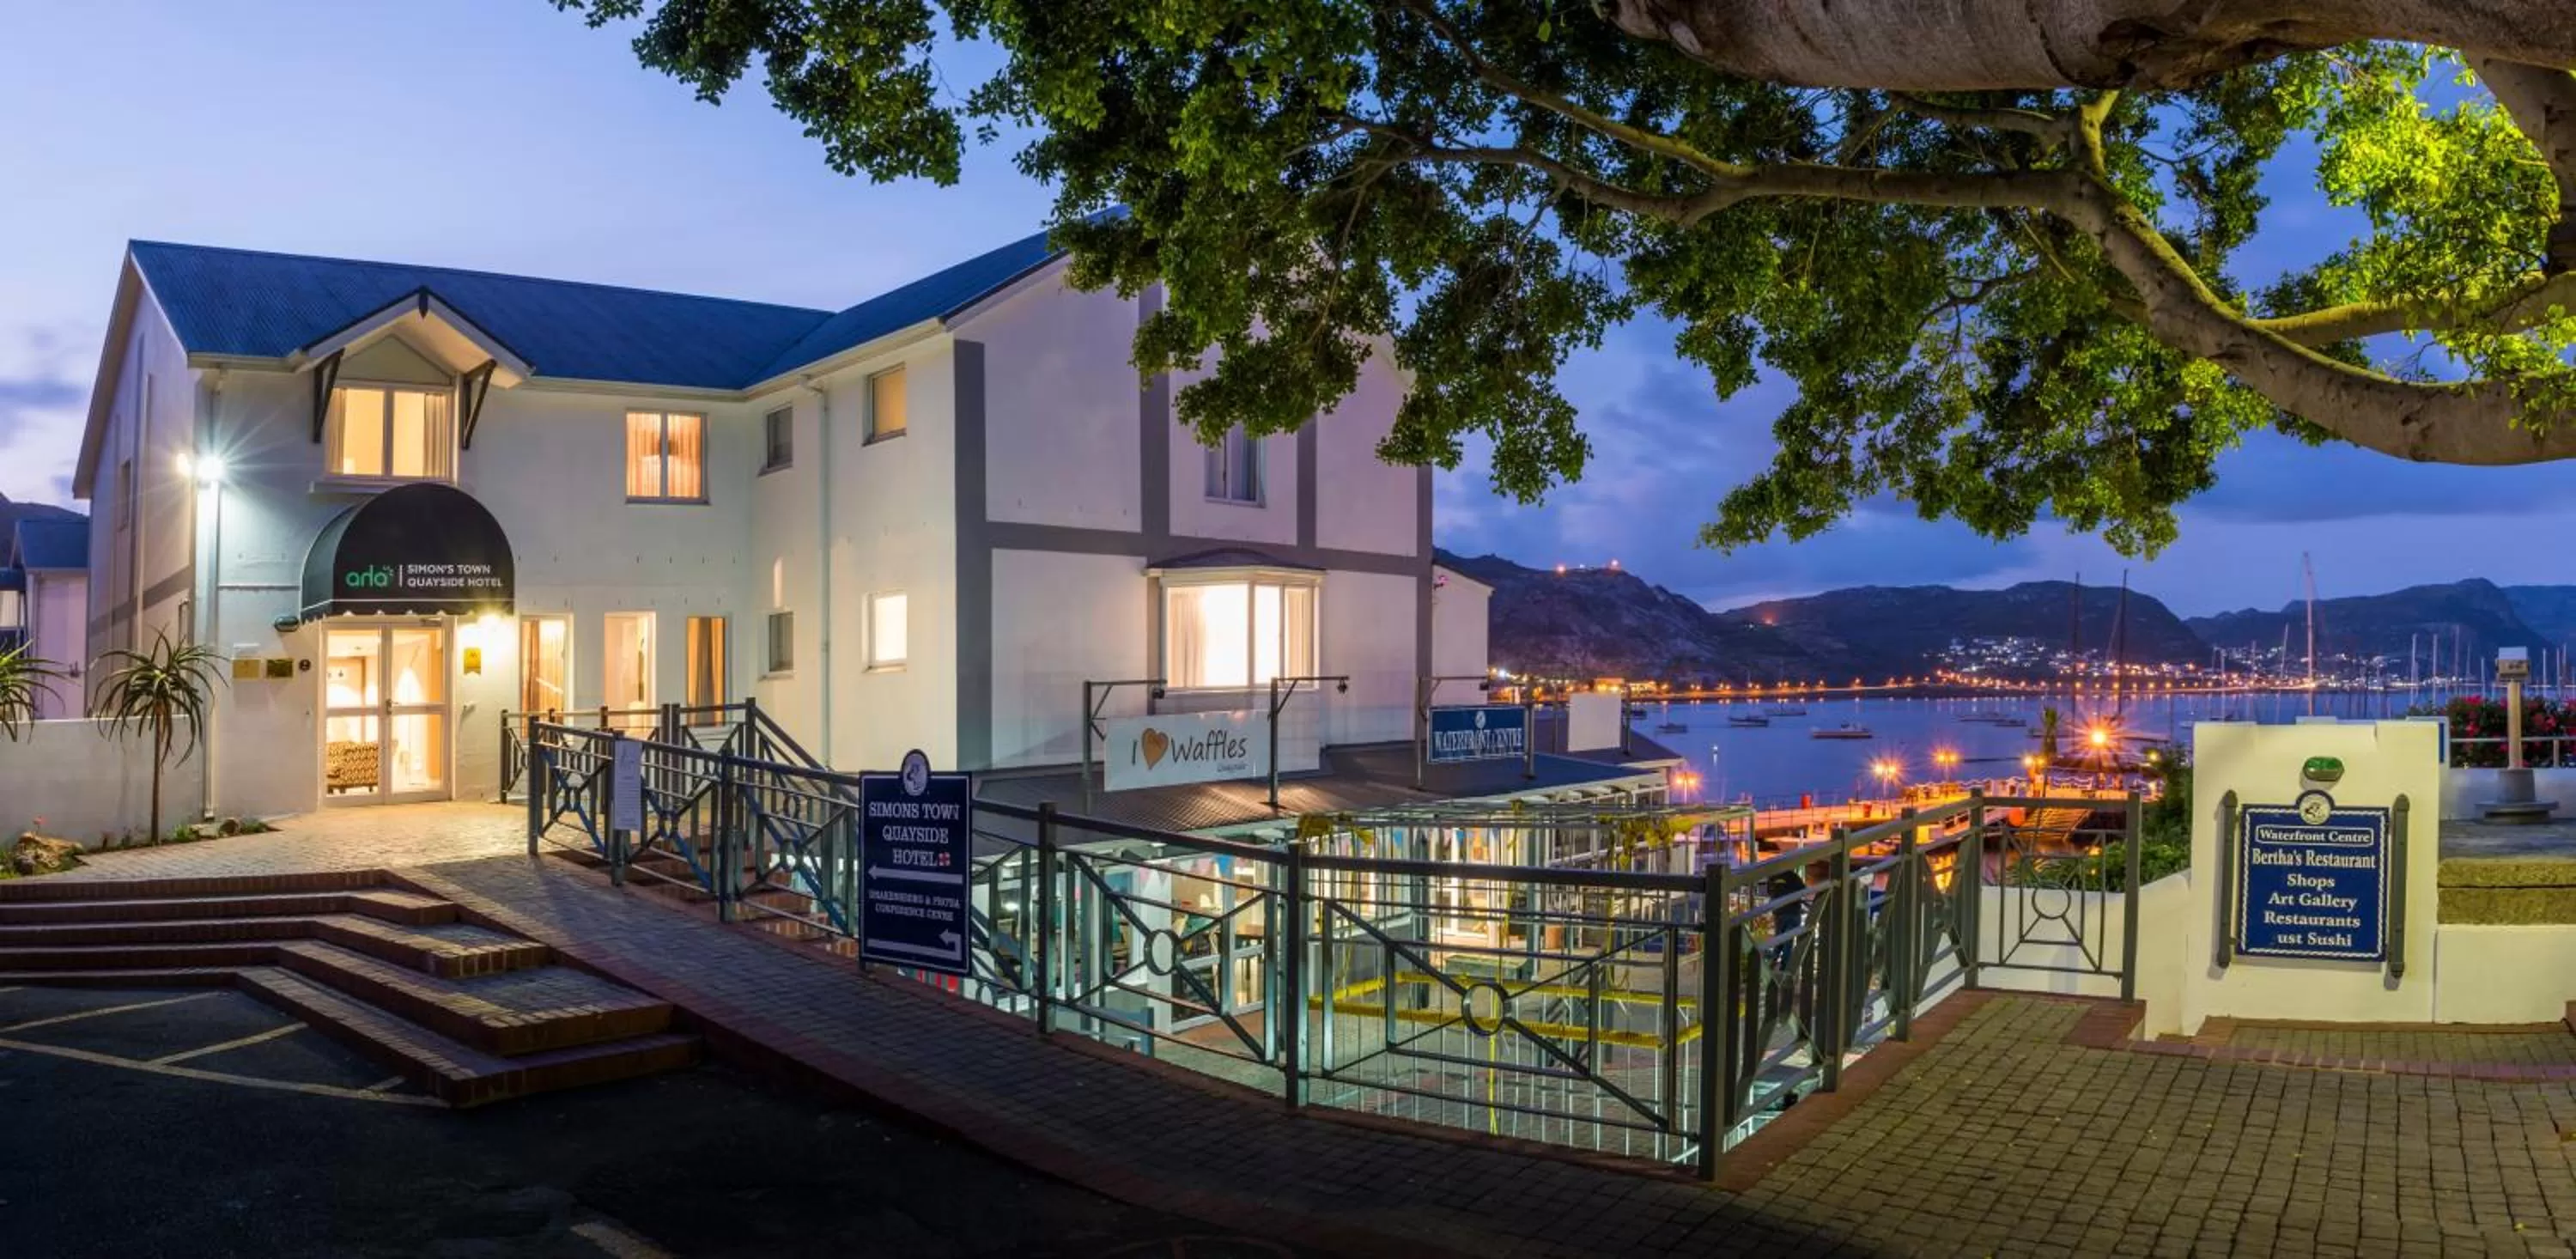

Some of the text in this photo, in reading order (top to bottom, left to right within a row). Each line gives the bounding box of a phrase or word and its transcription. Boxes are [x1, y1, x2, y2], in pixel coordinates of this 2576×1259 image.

[407, 564, 490, 574] SIMON'S TOWN
[407, 577, 502, 588] QUAYSIDE HOTEL
[1170, 729, 1248, 763] Waffles
[868, 801, 920, 818] SIMONS
[882, 825, 949, 844] QUAYSIDE
[2259, 829, 2371, 842] Waterfront Centre
[892, 848, 938, 867] HOTEL
[2252, 848, 2376, 868] Bertha's Restaurant
[2287, 873, 2336, 891] Shops
[2267, 892, 2358, 913] Art Gallery
[2263, 910, 2360, 928] Restaurants
[2307, 933, 2352, 946] Sushi
